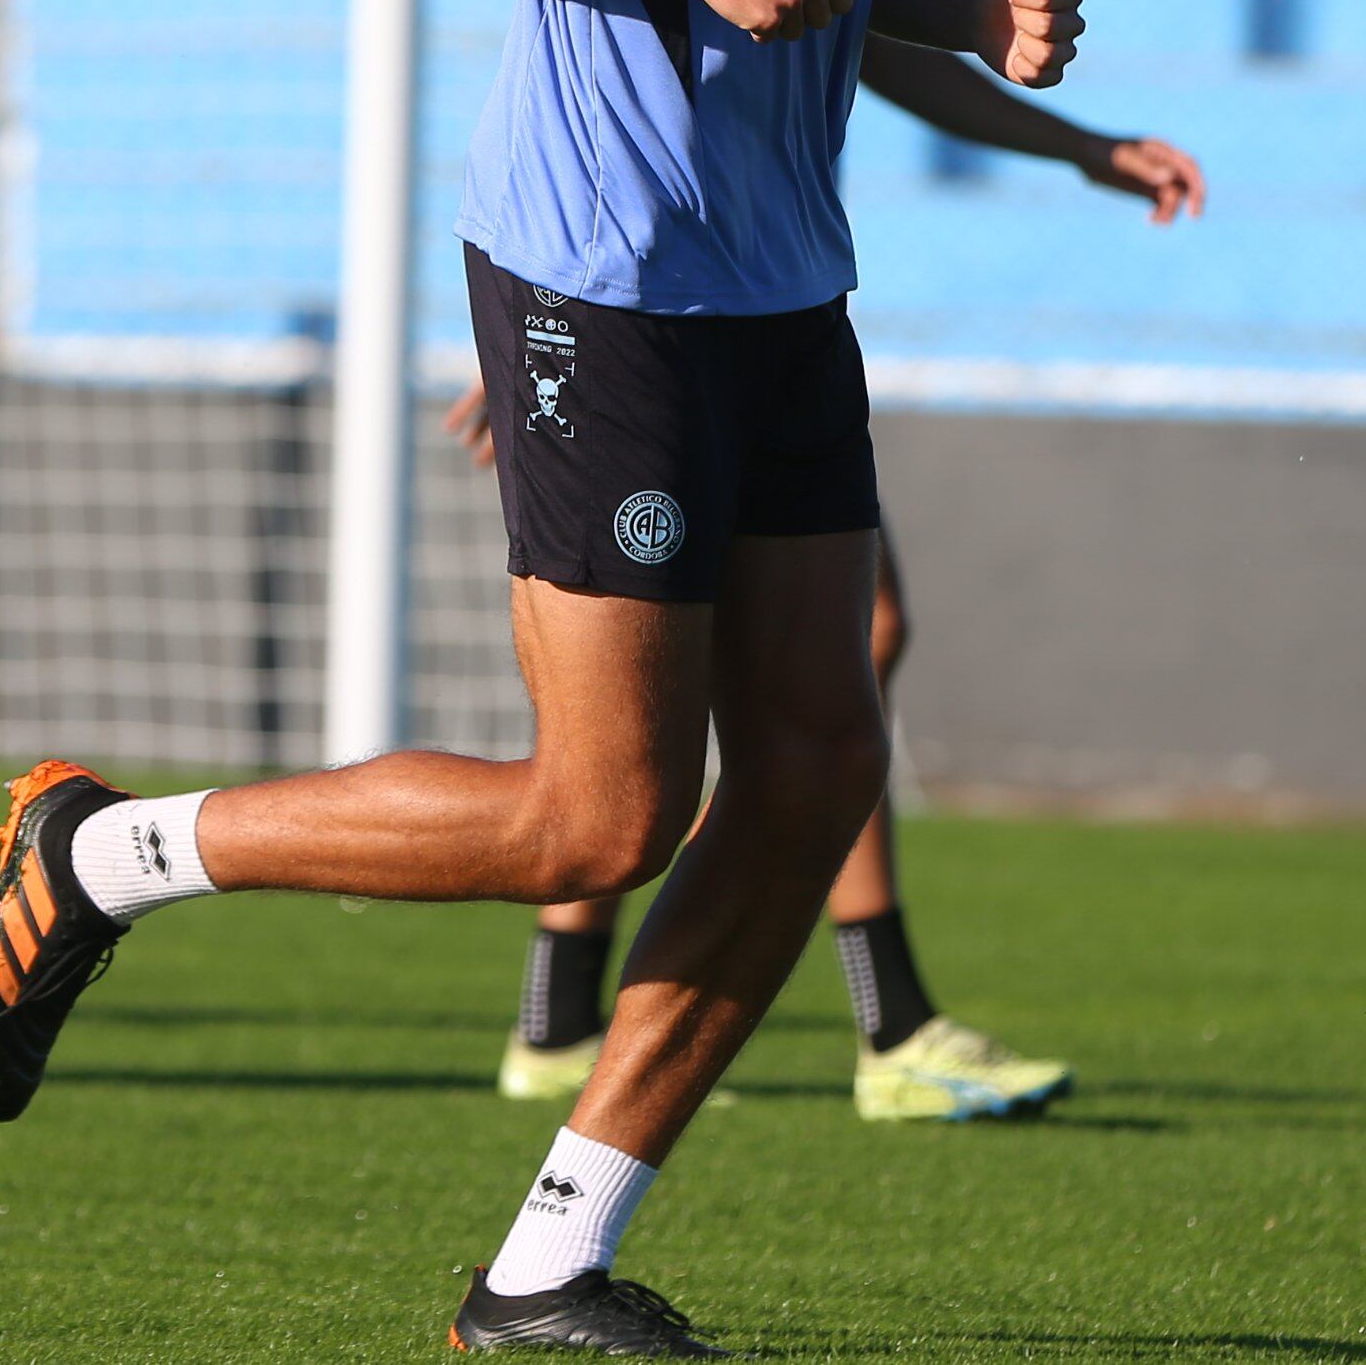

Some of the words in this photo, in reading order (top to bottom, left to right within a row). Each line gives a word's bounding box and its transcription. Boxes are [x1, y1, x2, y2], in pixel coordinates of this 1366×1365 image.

[556, 347, 576, 357] 2022
[619, 515, 627, 539] CLUB
[625, 495, 663, 515] ATLETICO
[131, 825, 151, 875] errea
[527, 1199, 568, 1217] errea
